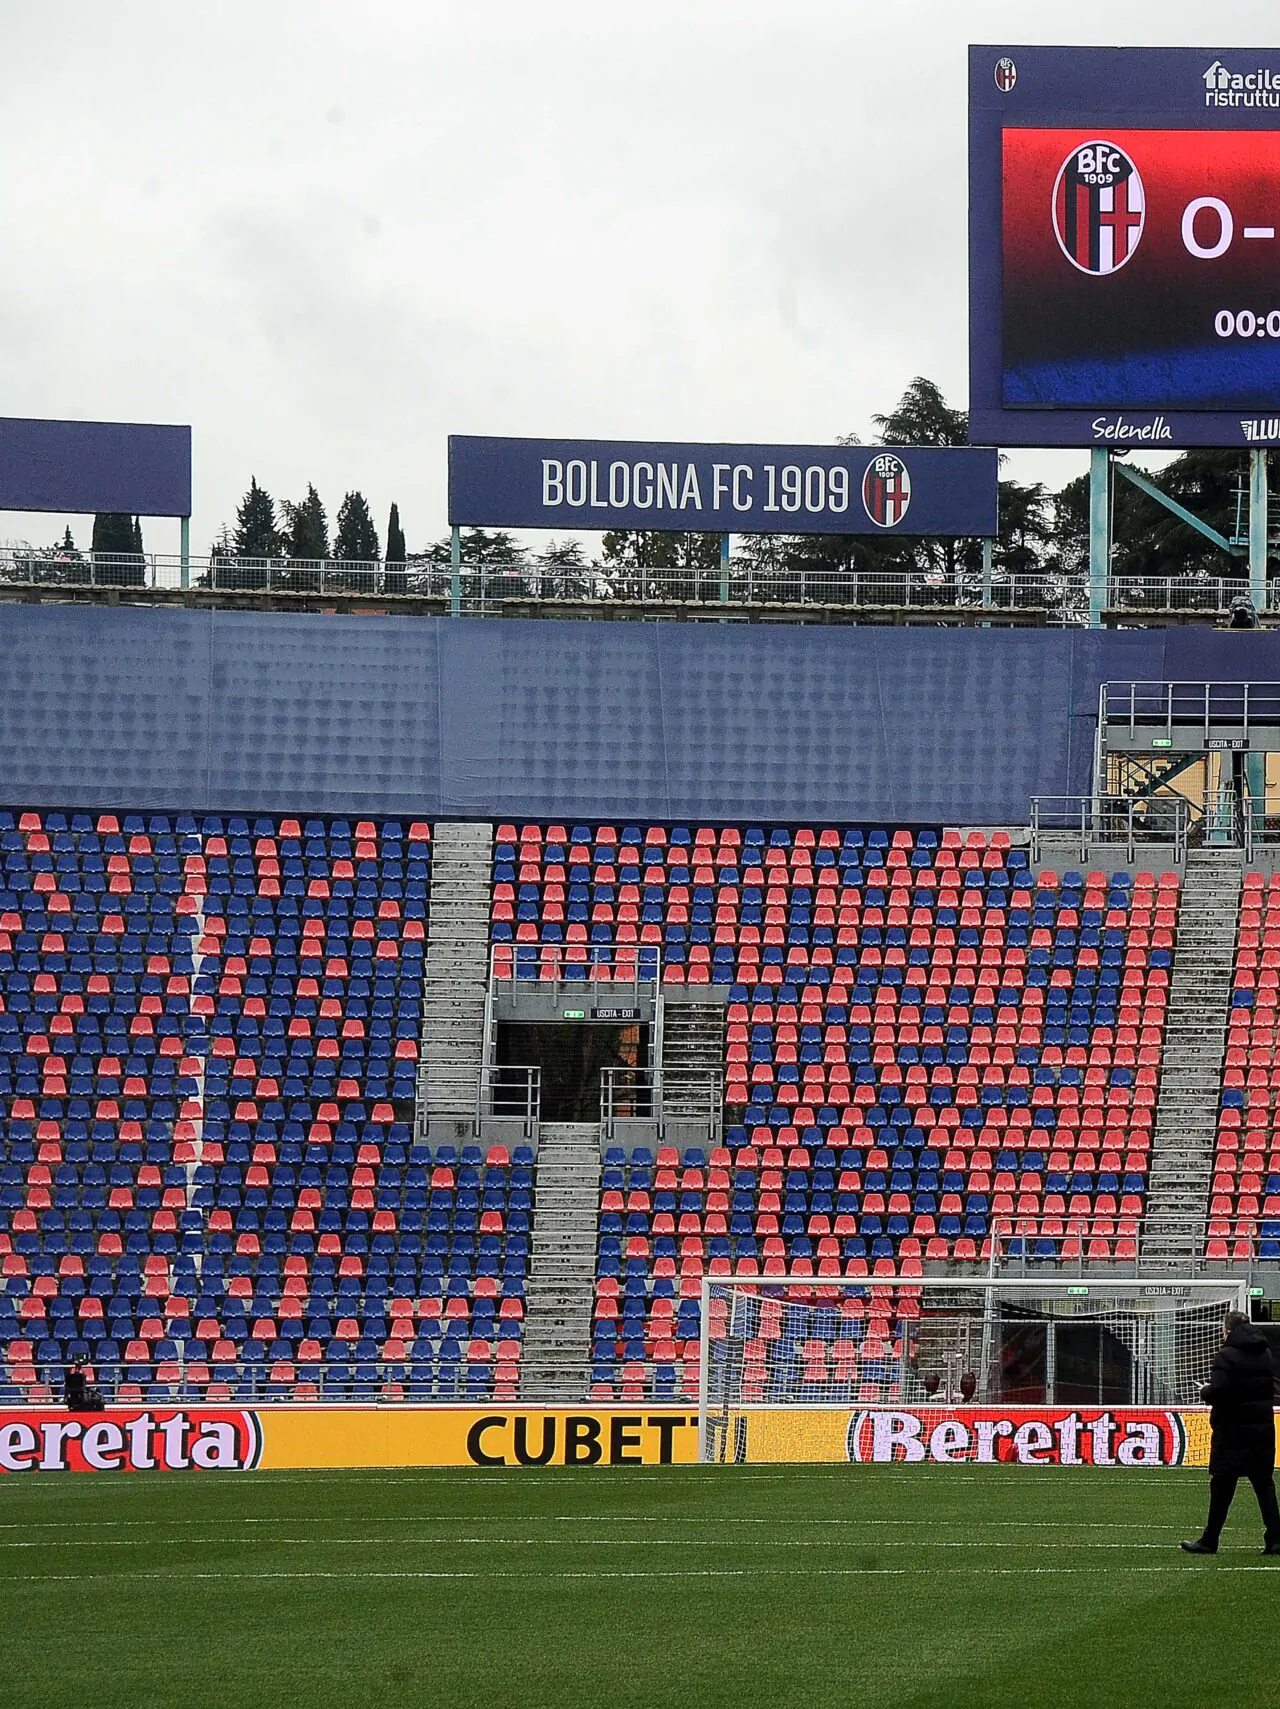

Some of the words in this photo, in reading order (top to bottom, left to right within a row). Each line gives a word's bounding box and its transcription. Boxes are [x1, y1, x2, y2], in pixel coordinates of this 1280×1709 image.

[1077, 146, 1120, 173] BFC
[1083, 174, 1113, 184] 1909
[1091, 416, 1172, 440] Selenella
[875, 457, 898, 472] BFC
[541, 459, 702, 510] BOLOGNA
[712, 464, 753, 511] FC
[763, 465, 849, 513] 1909
[597, 1010, 617, 1018] USCITA
[1172, 1287, 1184, 1295] EXIT
[466, 1417, 747, 1464] CUBETTI
[871, 1412, 1163, 1466] Beretta
